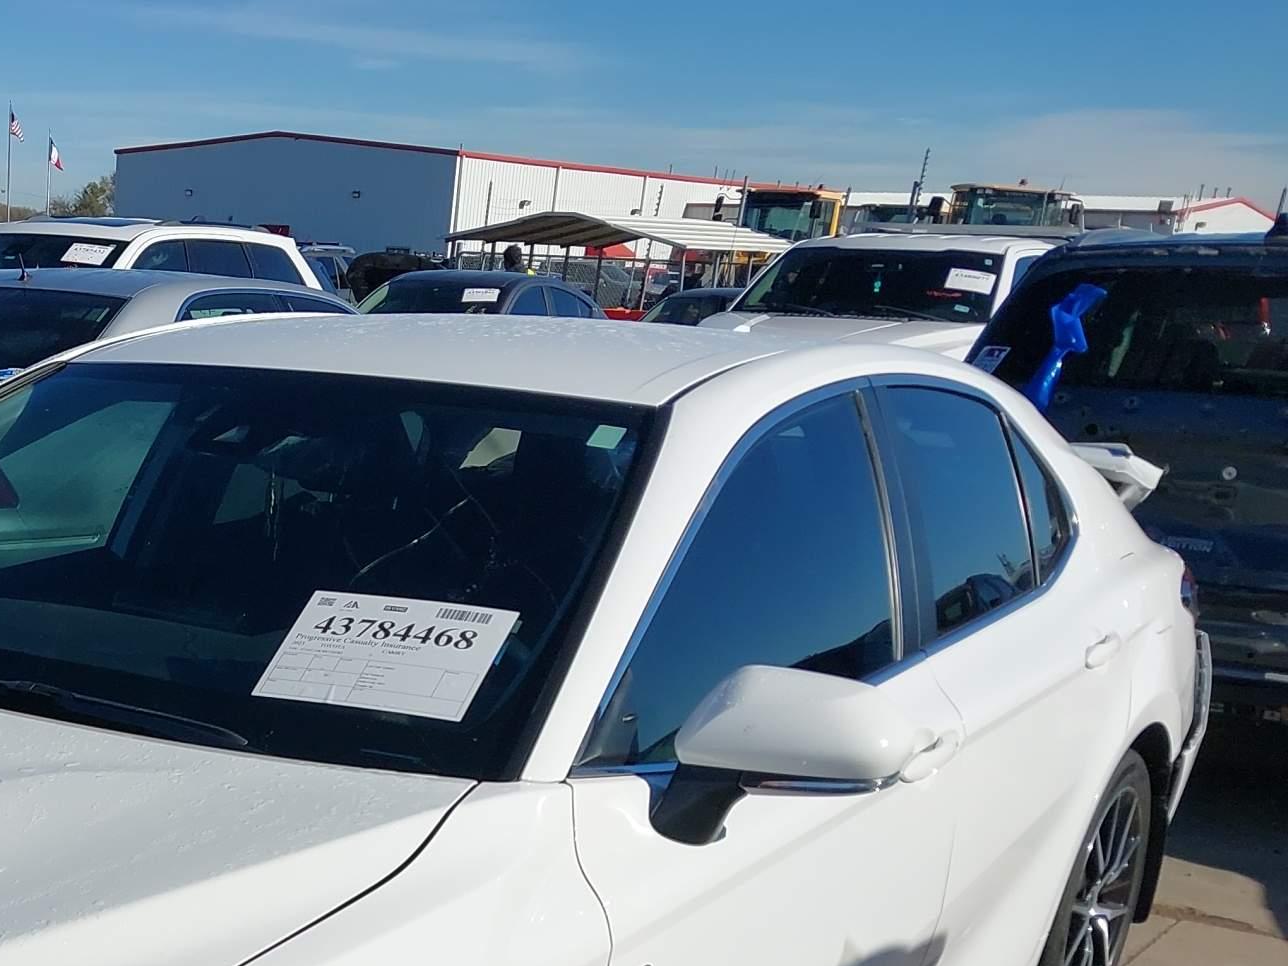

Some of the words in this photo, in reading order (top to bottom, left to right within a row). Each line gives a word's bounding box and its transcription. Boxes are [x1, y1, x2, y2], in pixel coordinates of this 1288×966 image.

[295, 632, 342, 644] Progressive
[343, 637, 379, 649] Casualty
[381, 641, 422, 652] Insurance
[313, 615, 478, 650] 43784468
